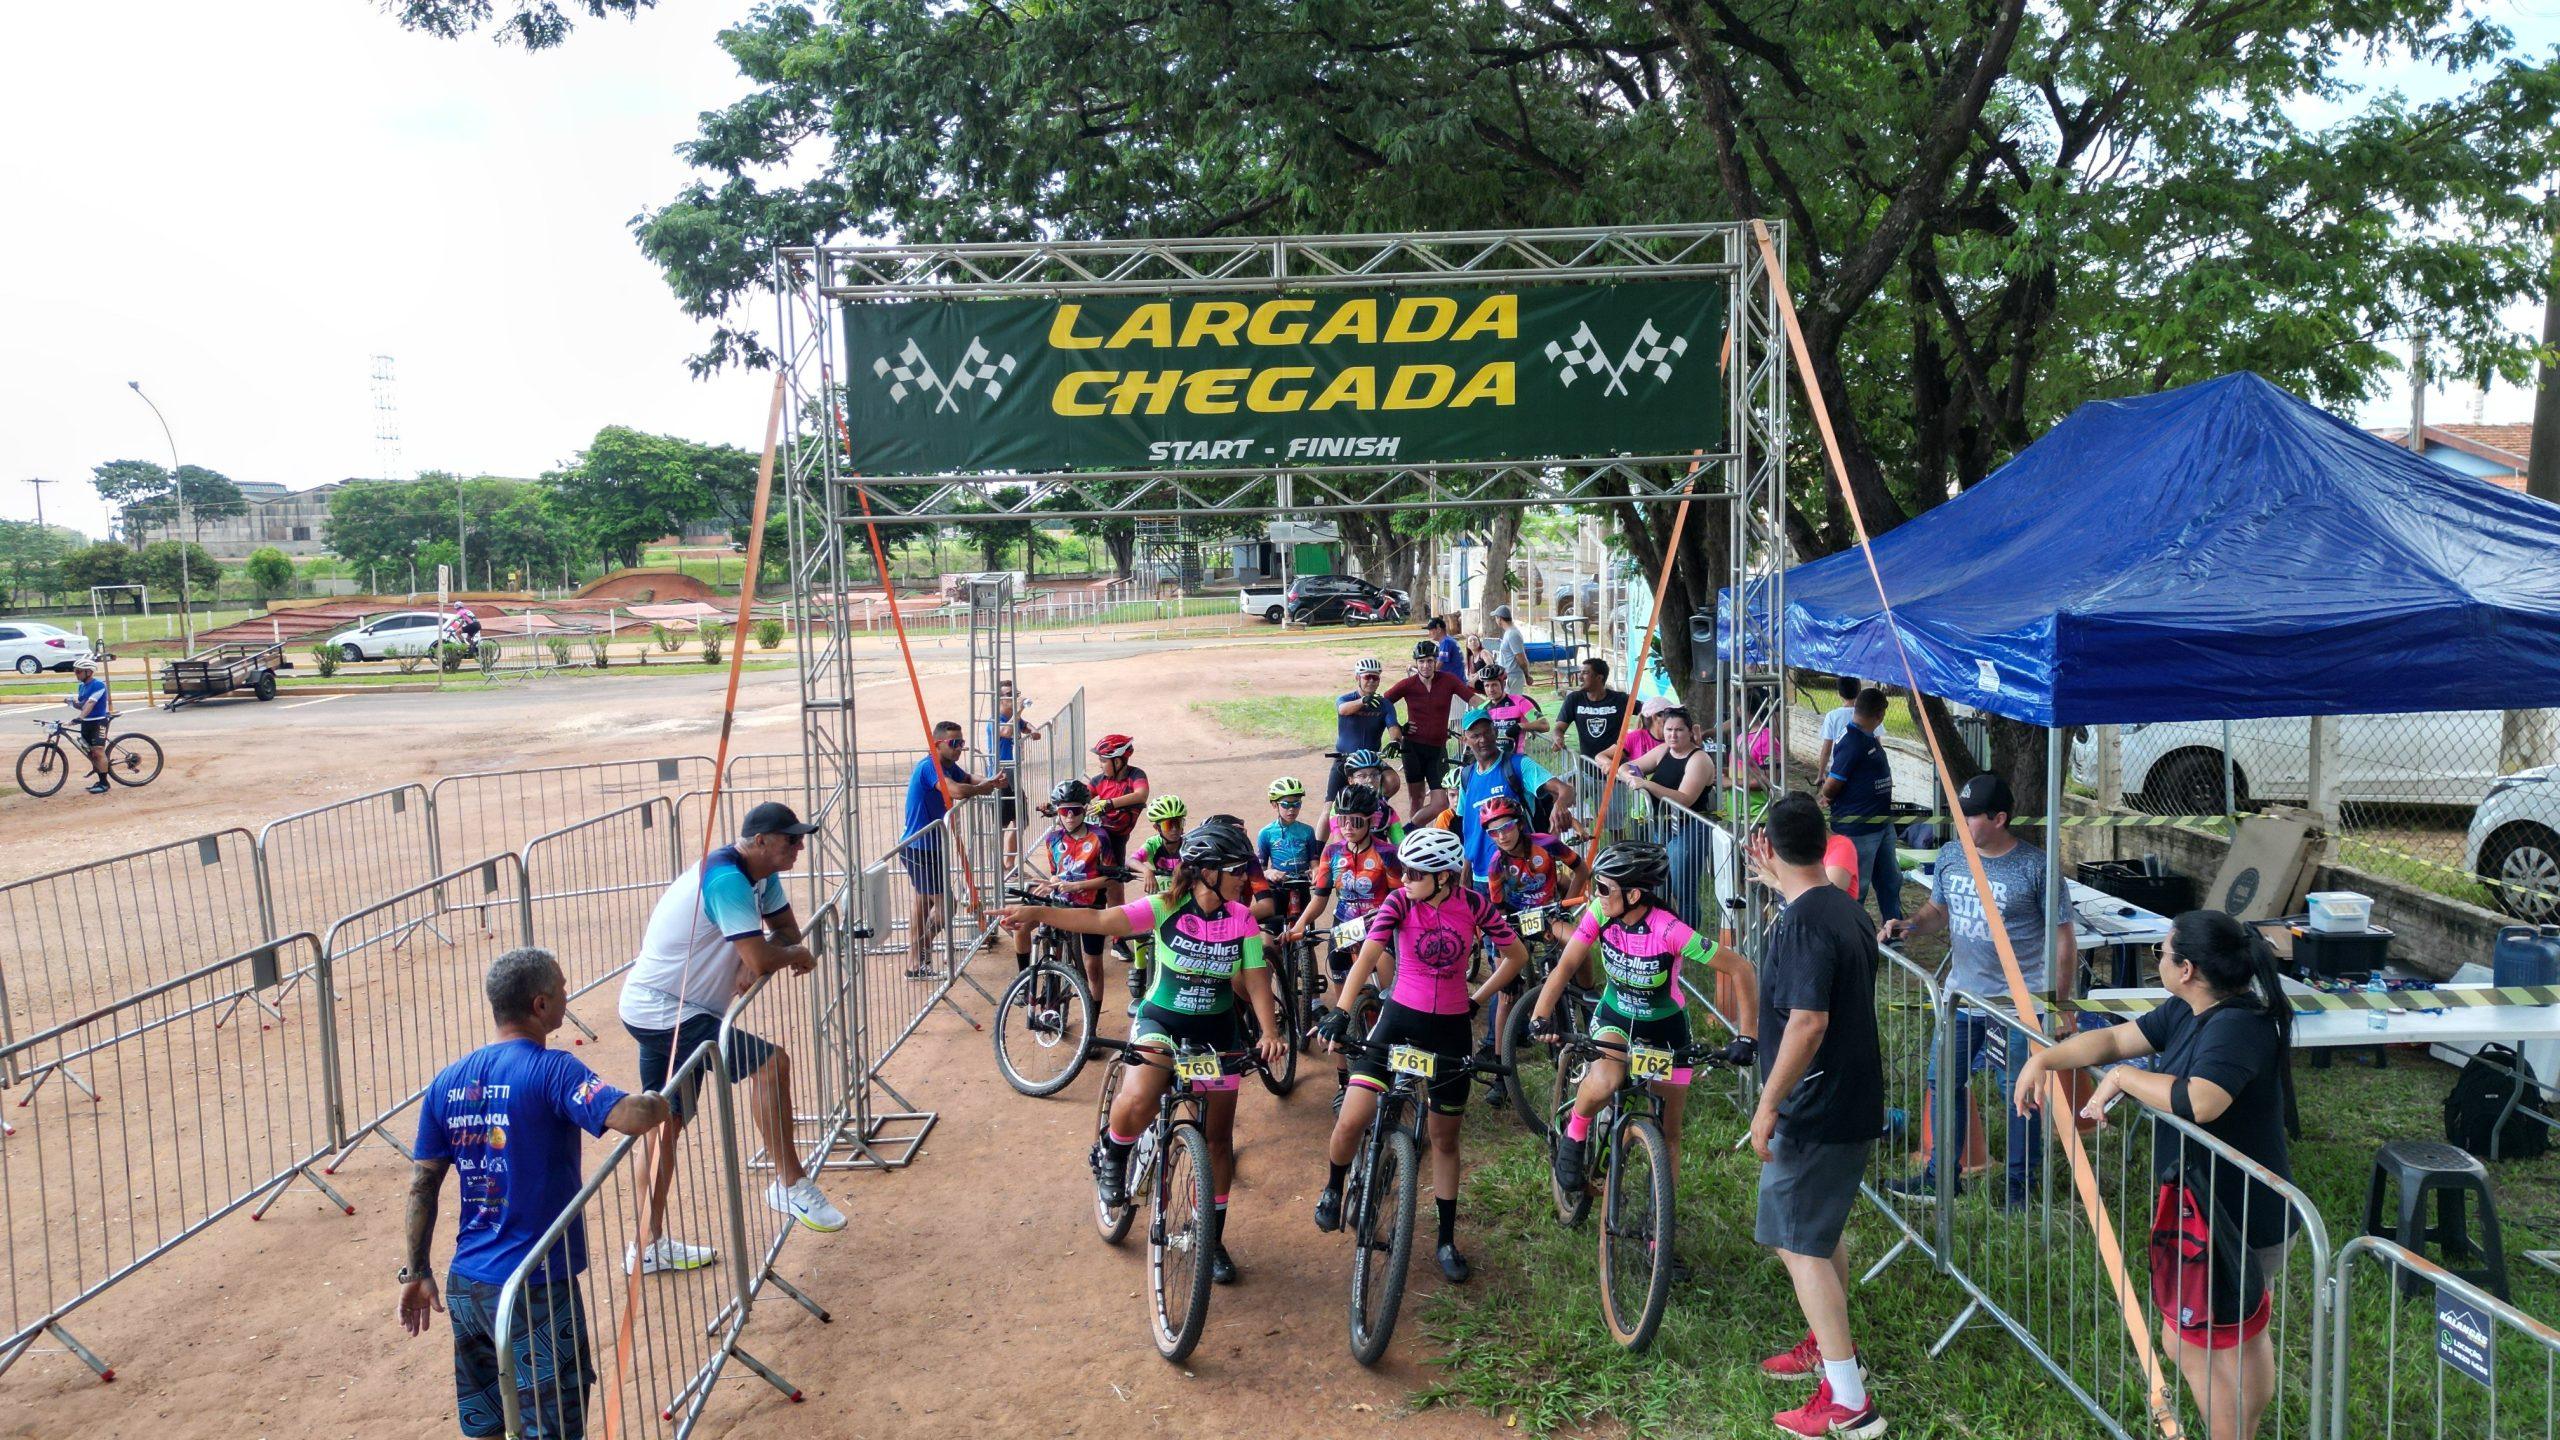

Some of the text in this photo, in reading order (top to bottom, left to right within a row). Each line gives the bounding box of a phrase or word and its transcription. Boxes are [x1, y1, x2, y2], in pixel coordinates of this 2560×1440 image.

[1048, 295, 1518, 350] LARGADA
[1051, 361, 1516, 417] CHEGADA
[1149, 439, 1255, 461] START
[1287, 437, 1401, 457] FINISH
[1577, 705, 1617, 715] RAIDERS
[1949, 874, 2008, 903] THR
[1521, 918, 1540, 933] 705
[1180, 1061, 1216, 1076] 760
[1396, 1052, 1428, 1073] 761
[1635, 1054, 1670, 1076] 762
[2440, 1311, 2488, 1345] KALANGAS
